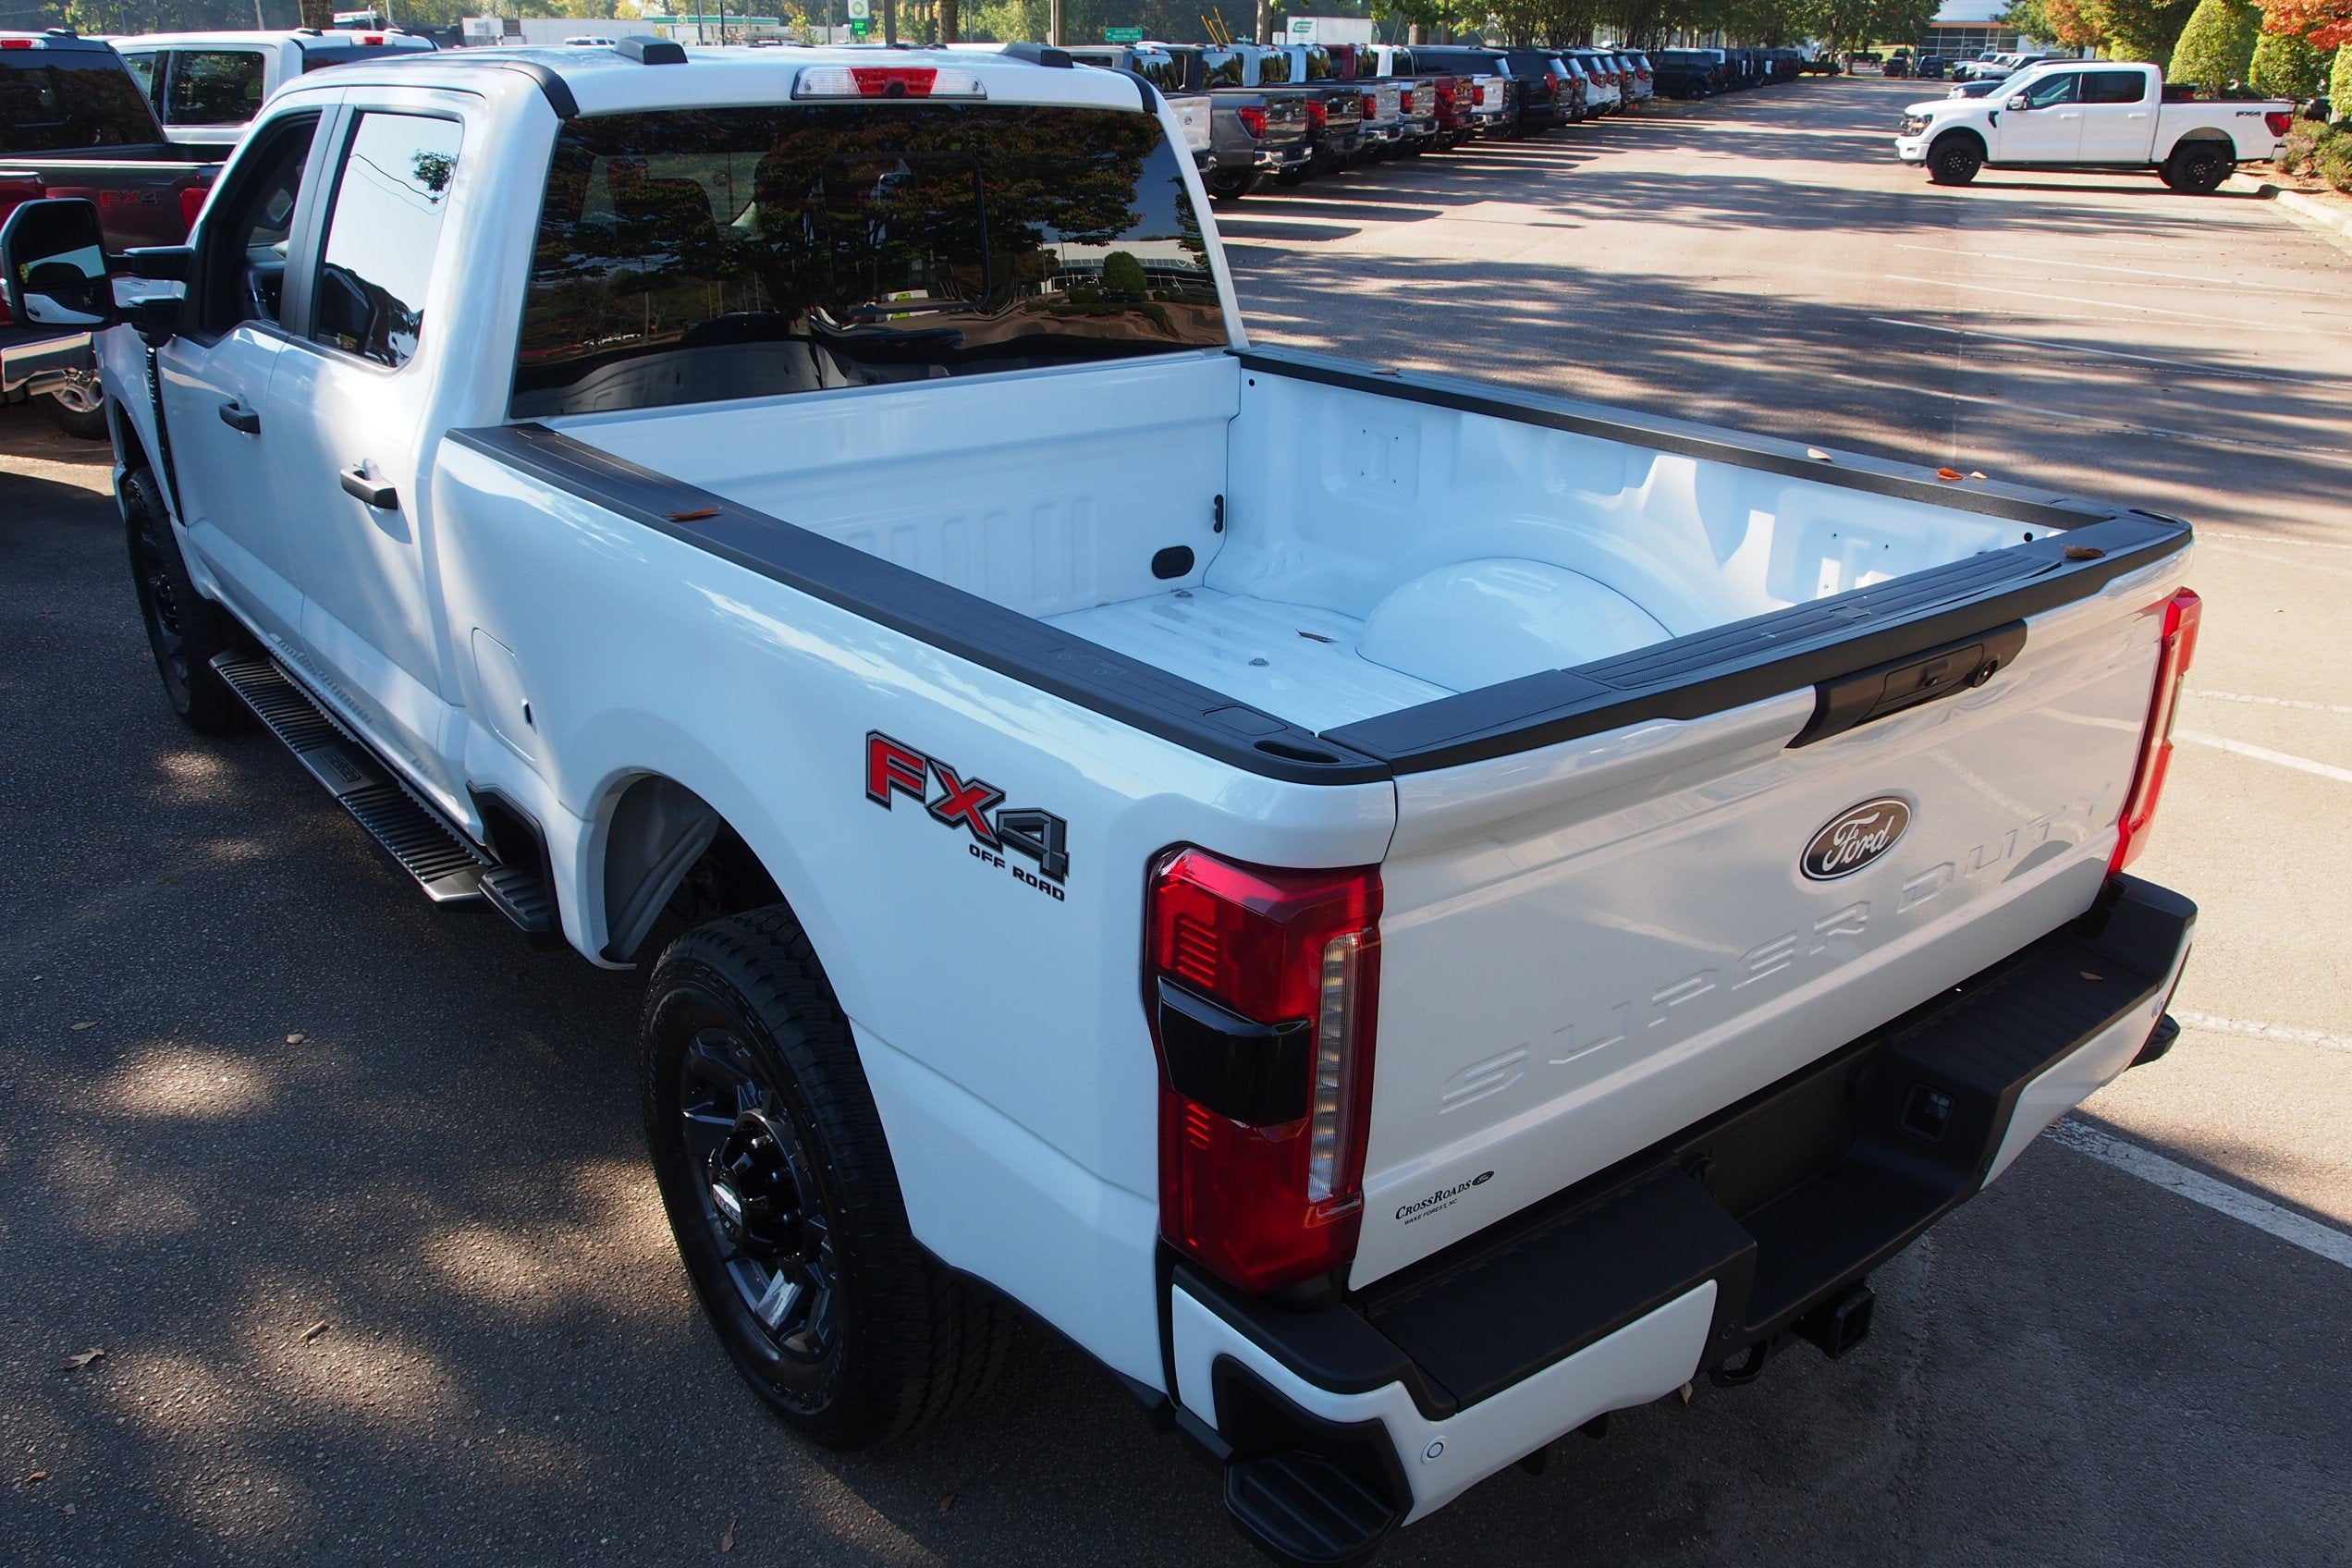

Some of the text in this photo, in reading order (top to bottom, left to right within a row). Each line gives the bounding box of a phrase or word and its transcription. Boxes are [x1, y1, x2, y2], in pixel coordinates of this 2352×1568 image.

[100, 190, 163, 208] FX4
[865, 729, 1070, 887] FX4
[1822, 812, 1894, 872] Ford
[969, 843, 1066, 902] OFF ROAD
[1439, 900, 1872, 1114] SUPER
[1449, 1198, 1458, 1207] NC
